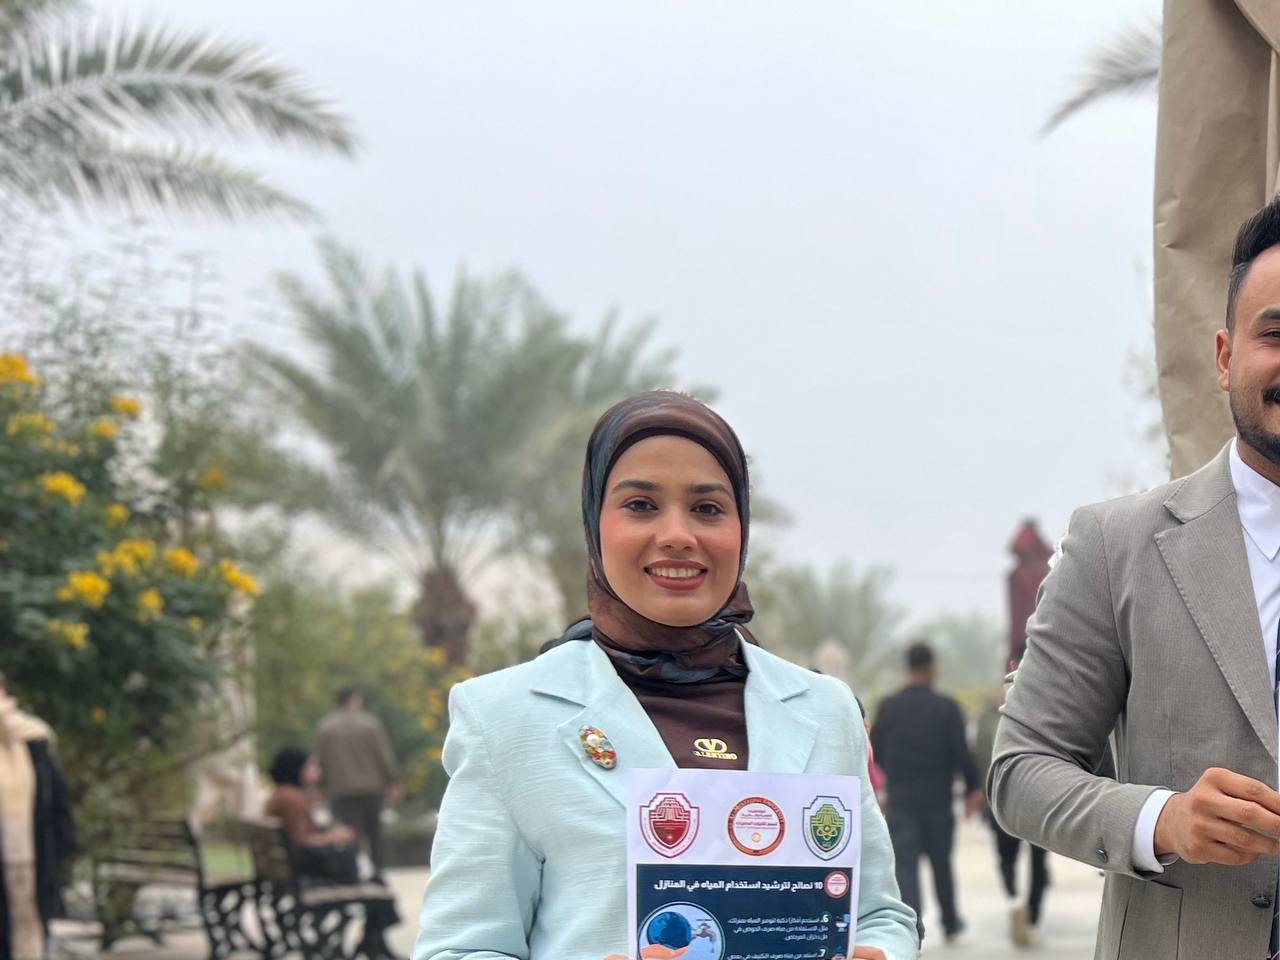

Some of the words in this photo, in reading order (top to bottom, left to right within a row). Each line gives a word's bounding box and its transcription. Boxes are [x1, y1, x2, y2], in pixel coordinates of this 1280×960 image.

[654, 880, 686, 890] المنازل
[686, 882, 700, 892] في
[701, 881, 724, 890] المياه
[725, 881, 761, 891] استخدام
[762, 881, 790, 891] لترشيد
[791, 881, 813, 892] نصائح
[814, 881, 824, 890] 10
